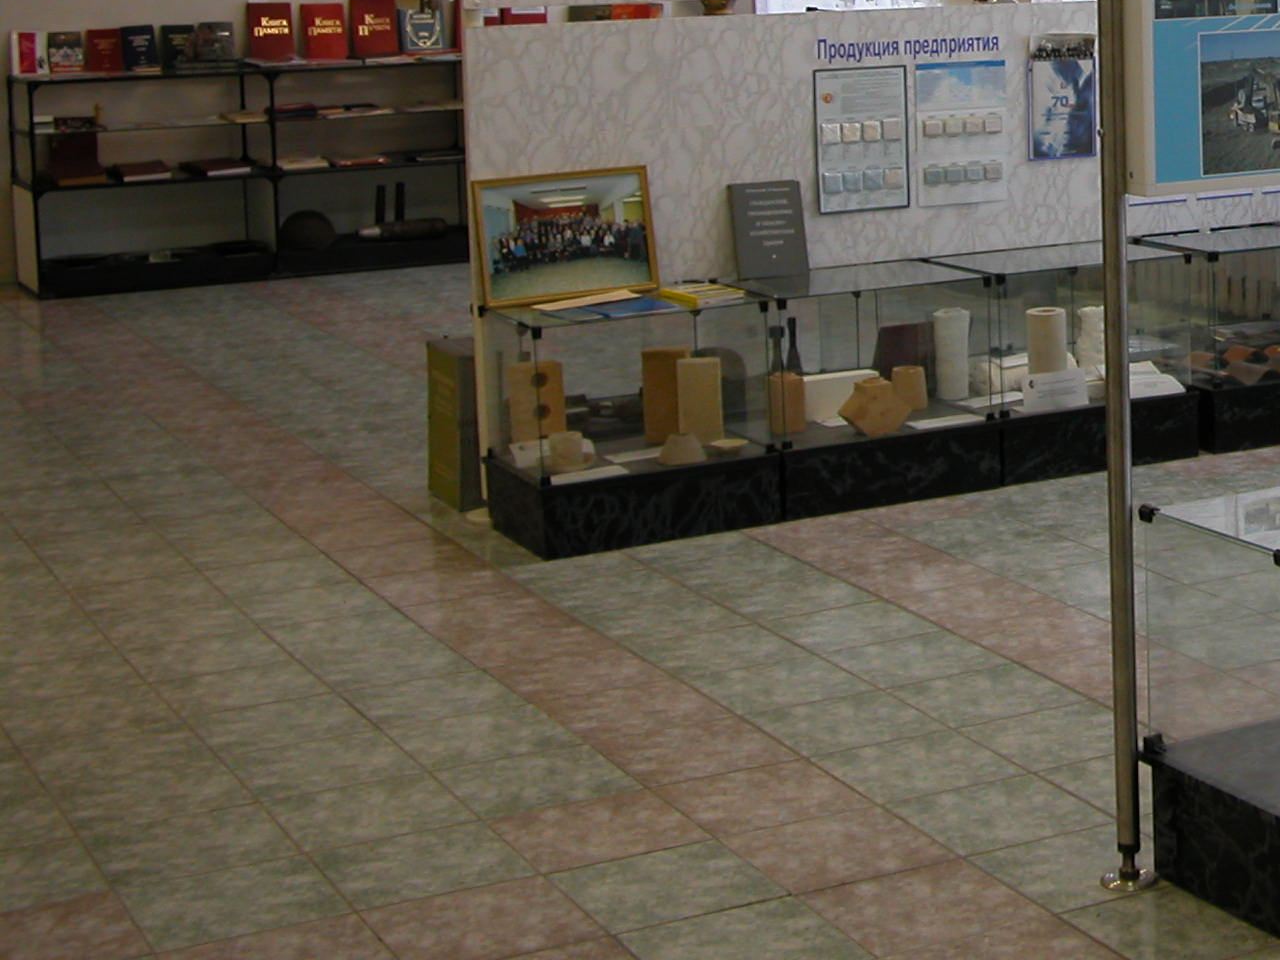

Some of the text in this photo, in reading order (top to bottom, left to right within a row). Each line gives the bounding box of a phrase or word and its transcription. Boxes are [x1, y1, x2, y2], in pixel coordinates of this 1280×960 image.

[817, 35, 1000, 64] Продукция предприятия
[1051, 95, 1069, 108] 70
